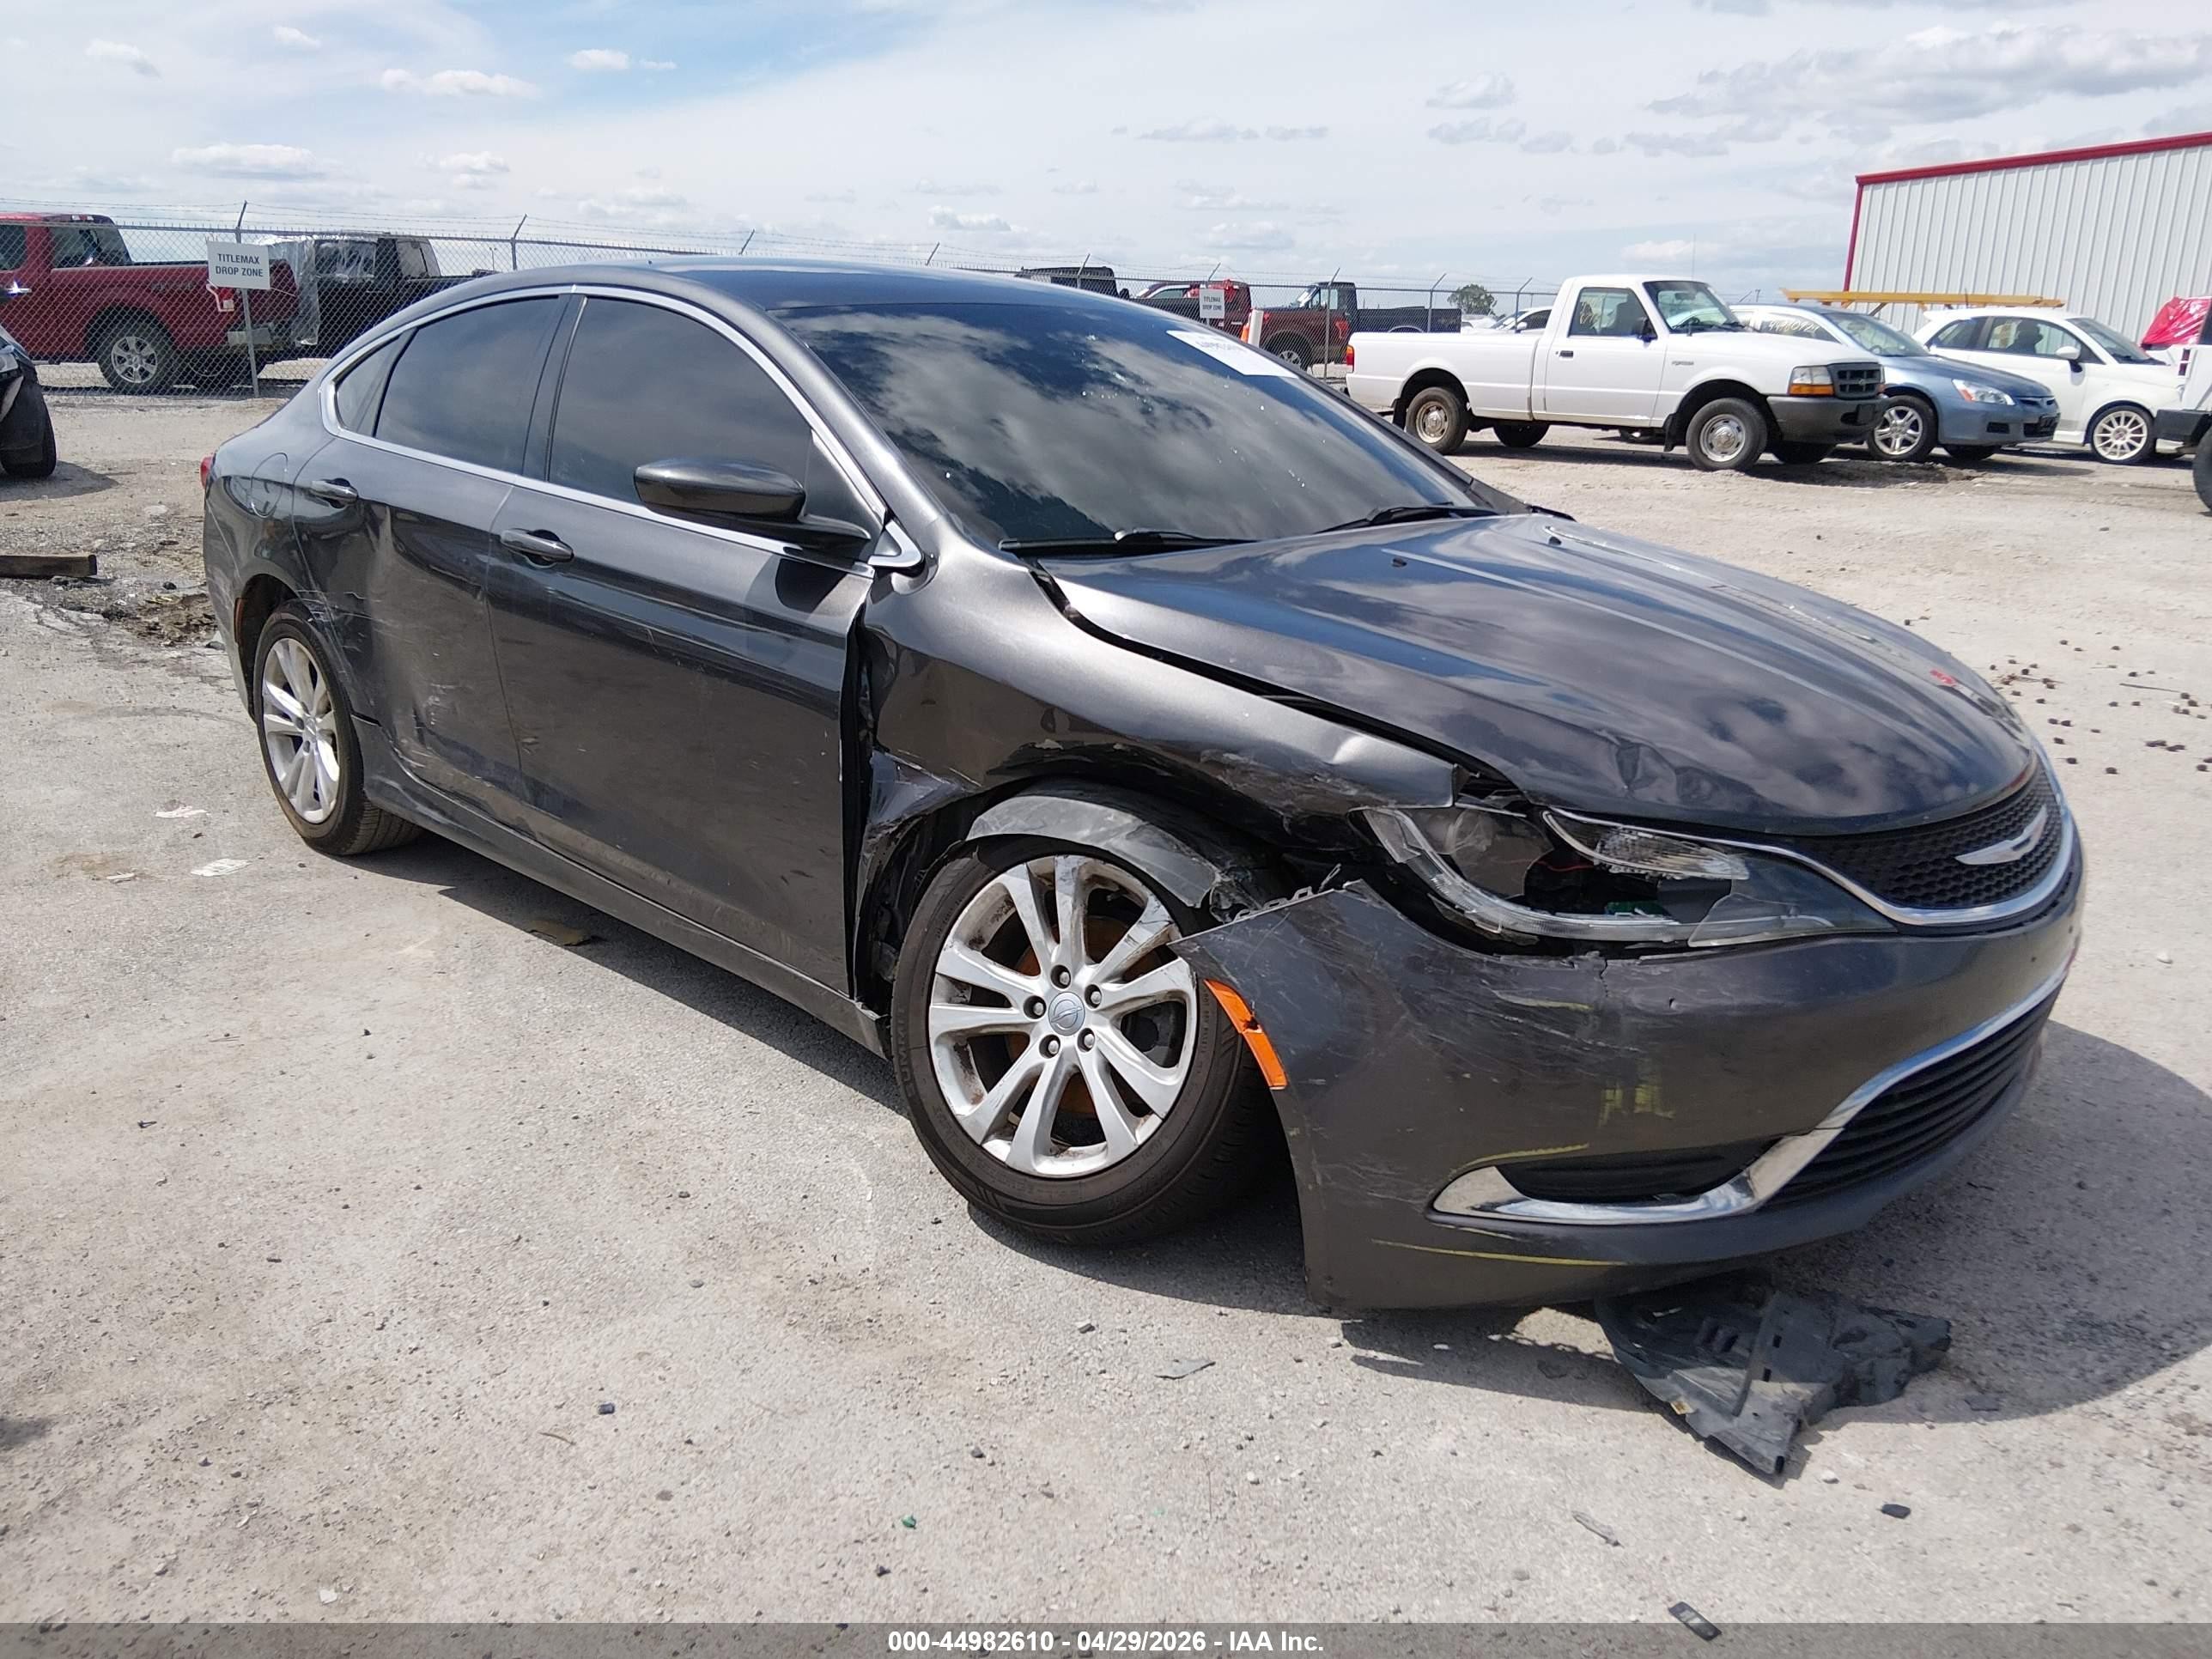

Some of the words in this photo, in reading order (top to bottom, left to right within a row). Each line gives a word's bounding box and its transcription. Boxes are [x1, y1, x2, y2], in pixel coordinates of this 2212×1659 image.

[217, 253, 260, 264] TITLEMAX
[216, 265, 239, 276] DROP
[241, 267, 264, 276] ZONE
